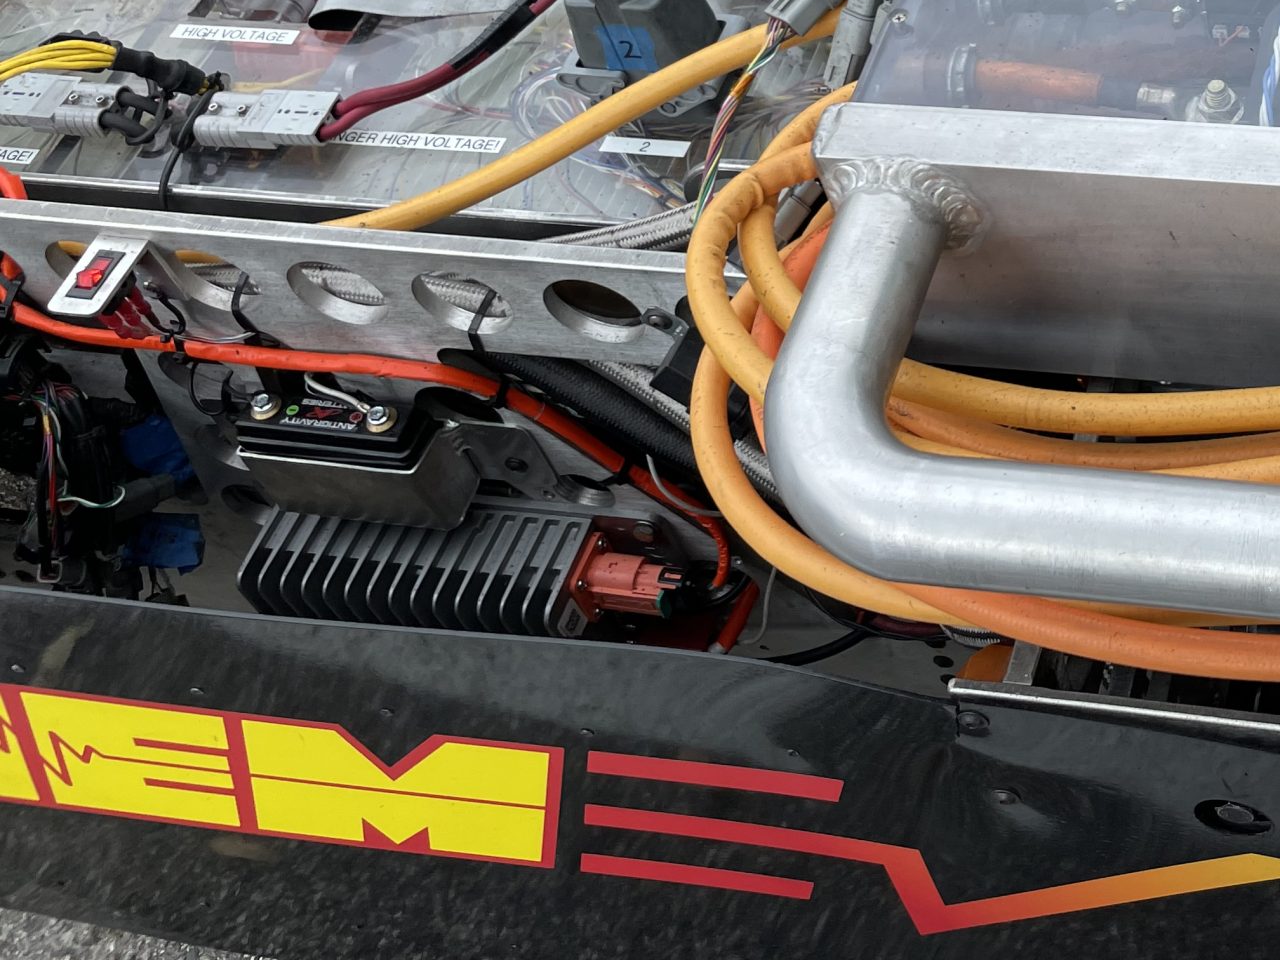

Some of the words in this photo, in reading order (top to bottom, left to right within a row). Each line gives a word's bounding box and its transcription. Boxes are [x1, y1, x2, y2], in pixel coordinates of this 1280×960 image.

[182, 26, 218, 38] HIGH
[221, 29, 290, 42] VOLTAGE
[619, 40, 642, 59] 2
[337, 131, 379, 143] NGER
[378, 133, 420, 148] HIGH
[422, 136, 500, 152] VOLTAGE!
[639, 141, 651, 153] 2
[0, 148, 34, 162] AGE!
[281, 417, 357, 431] ANTIGRAVITY
[0, 685, 560, 866] EM
